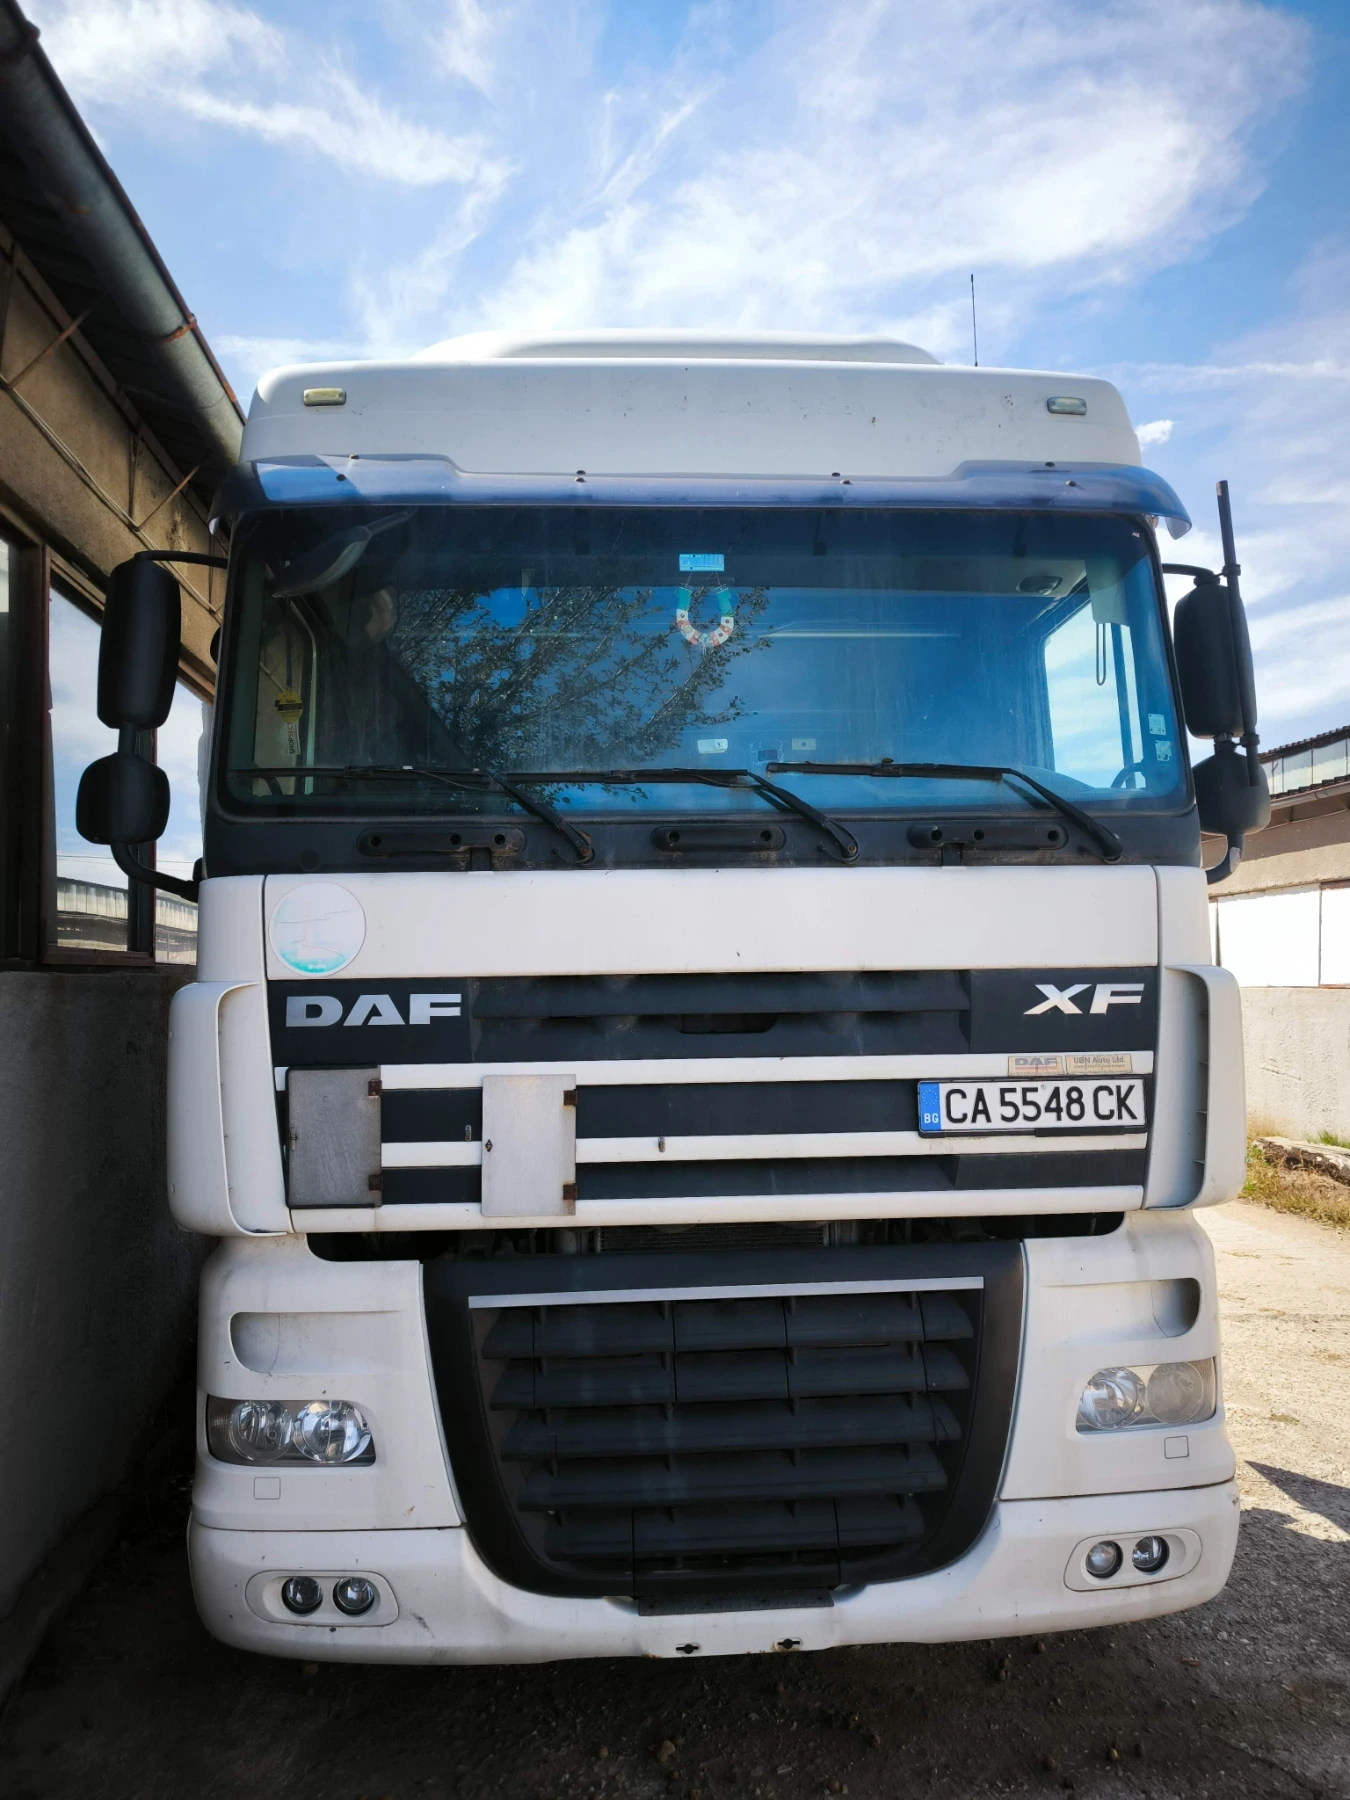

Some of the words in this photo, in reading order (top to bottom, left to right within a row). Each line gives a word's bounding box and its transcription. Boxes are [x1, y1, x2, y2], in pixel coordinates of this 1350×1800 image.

[1023, 983, 1145, 1015] XF
[286, 993, 462, 1027] DAF
[1015, 1057, 1057, 1066] DAF
[1073, 1056, 1091, 1064] UBN
[1092, 1056, 1111, 1064] Auto
[924, 1112, 940, 1124] BG
